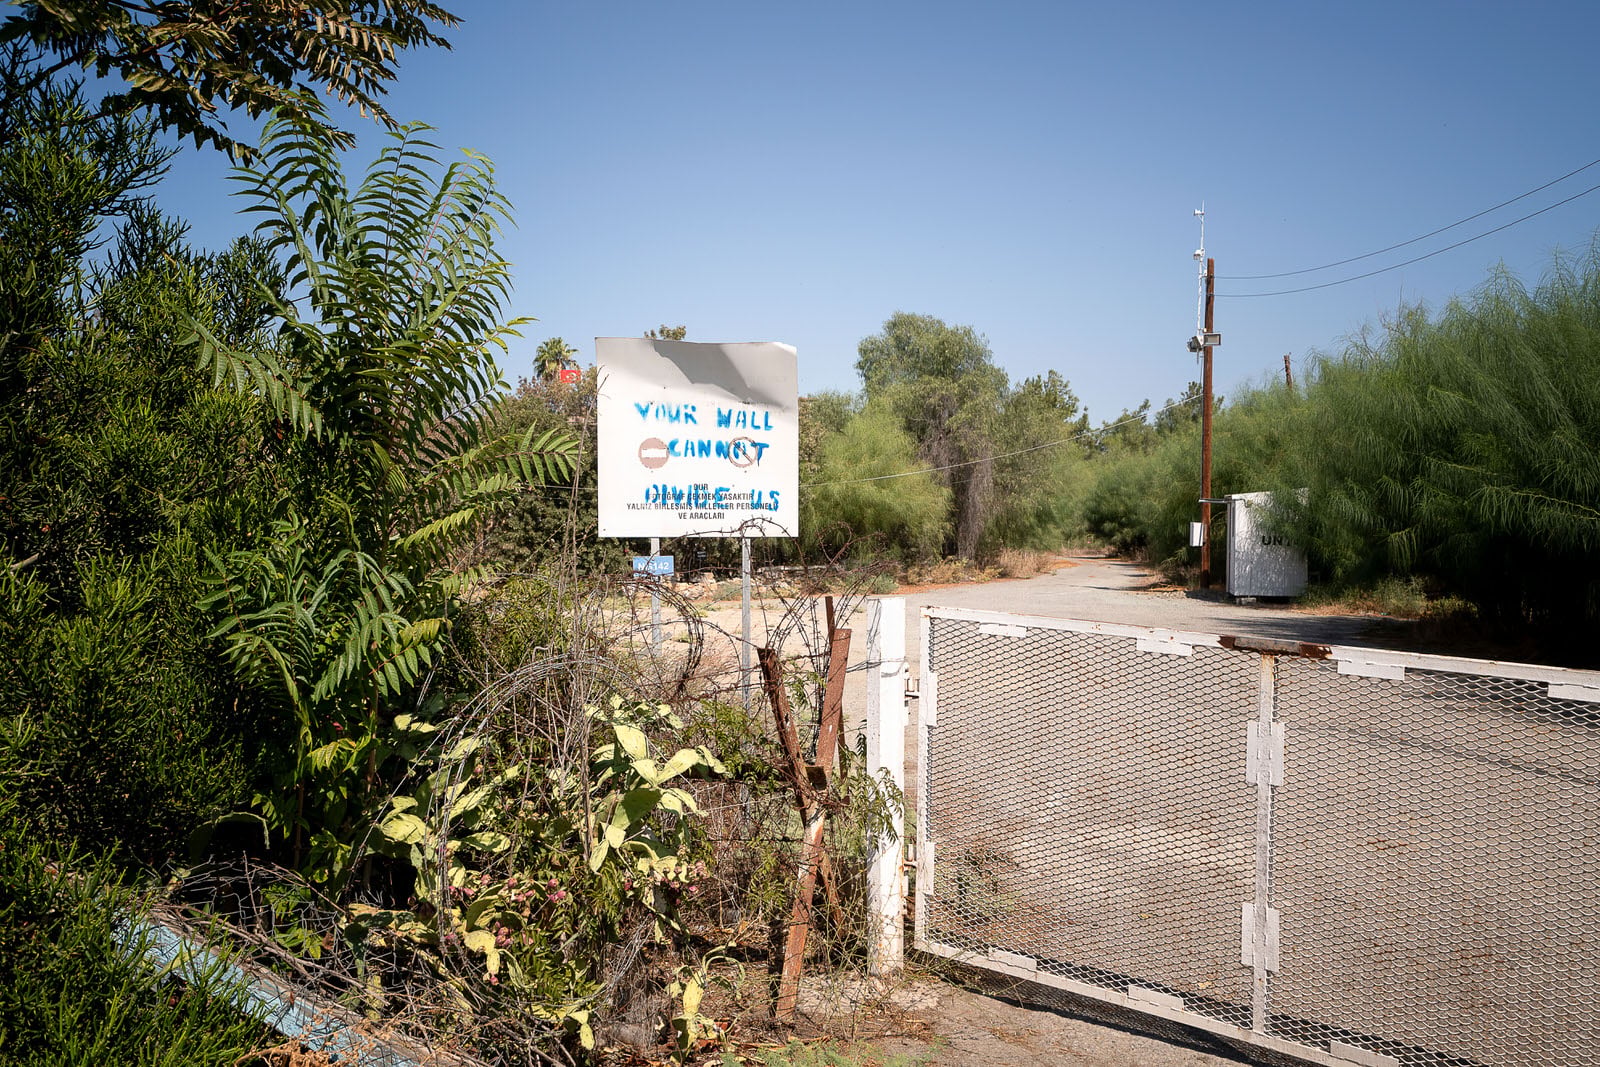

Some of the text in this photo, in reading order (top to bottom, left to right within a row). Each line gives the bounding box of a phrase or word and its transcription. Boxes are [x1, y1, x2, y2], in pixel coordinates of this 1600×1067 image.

[634, 402, 773, 431] YOUR WALL
[668, 438, 770, 466] CANNOT
[693, 483, 709, 491] DUR
[751, 489, 780, 512] US
[678, 512, 687, 520] VE
